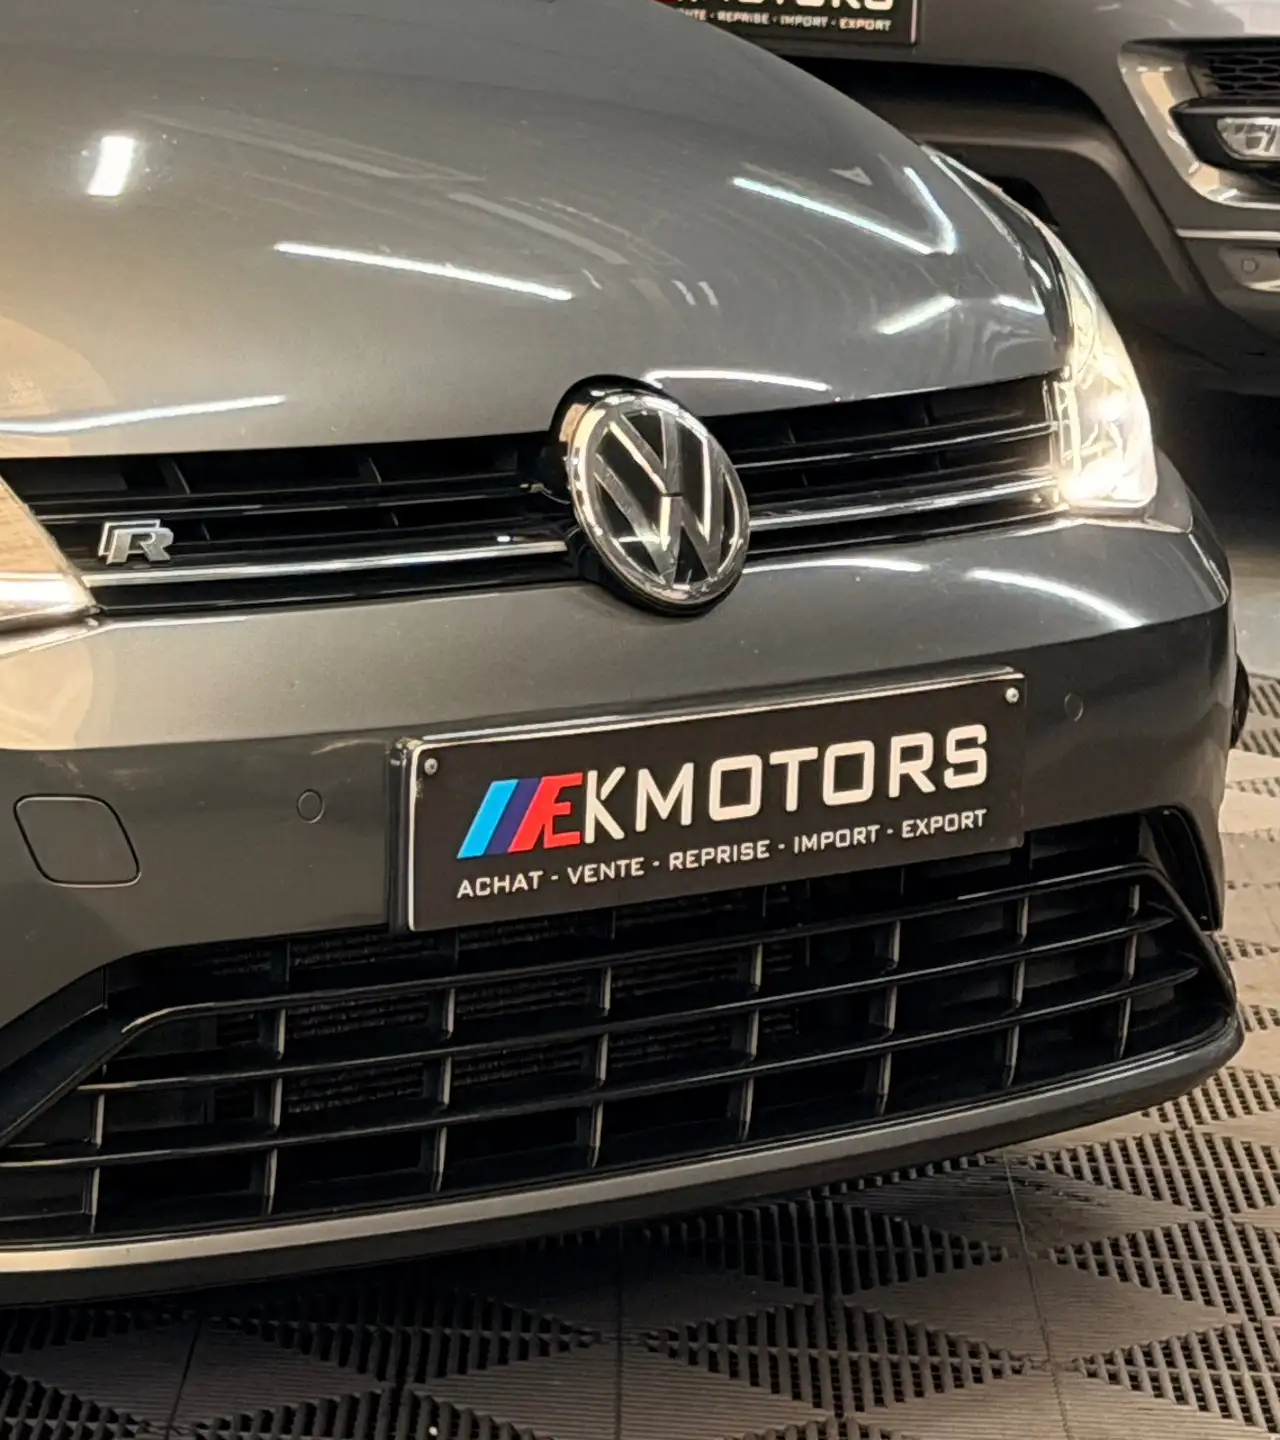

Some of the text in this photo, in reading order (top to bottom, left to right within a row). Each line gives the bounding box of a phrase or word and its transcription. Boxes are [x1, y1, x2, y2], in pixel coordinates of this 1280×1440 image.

[780, 14, 827, 27] IMPORT
[839, 18, 892, 31] EXPORT
[98, 518, 174, 566] R
[456, 871, 543, 899] ACHAT
[568, 856, 645, 885] VENTE
[669, 839, 770, 871] REPRISE
[794, 824, 880, 854] IMPORT
[901, 808, 987, 838] EXPORT
